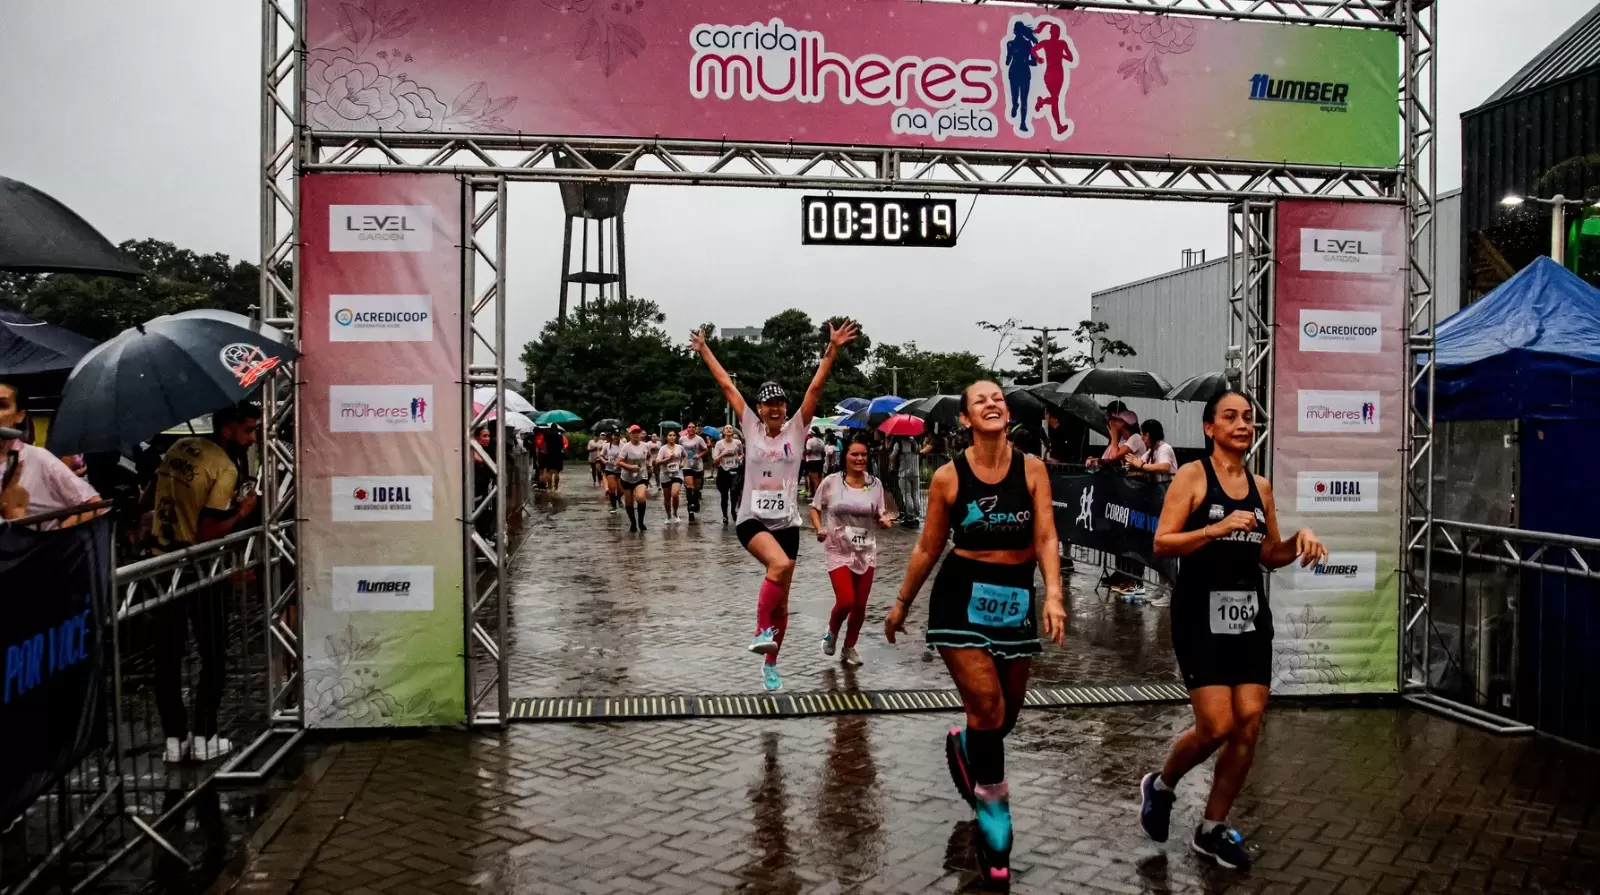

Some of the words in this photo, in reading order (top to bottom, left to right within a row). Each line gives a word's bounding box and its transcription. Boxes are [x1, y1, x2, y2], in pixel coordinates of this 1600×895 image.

[696, 24, 797, 51] corrida
[696, 36, 992, 104] mulheres
[897, 113, 927, 129] na
[938, 109, 992, 135] pista
[346, 216, 415, 231] LEVEL
[808, 202, 952, 241] 00:30:19
[358, 233, 404, 241] GARDEN
[1314, 239, 1368, 254] LEVEL
[354, 312, 428, 322] ACREDICOOP
[1320, 325, 1378, 336] ACREDICOOP
[341, 404, 408, 418] mulheres
[1306, 407, 1360, 420] mulheres
[373, 487, 411, 502] IDEAL
[1330, 481, 1360, 494] IDEAL
[757, 499, 784, 510] 1278
[1105, 502, 1129, 528] CORRA
[1130, 510, 1145, 529] POR
[975, 597, 1021, 617] 3015
[1217, 605, 1255, 621] 1061
[4, 632, 45, 704] POR
